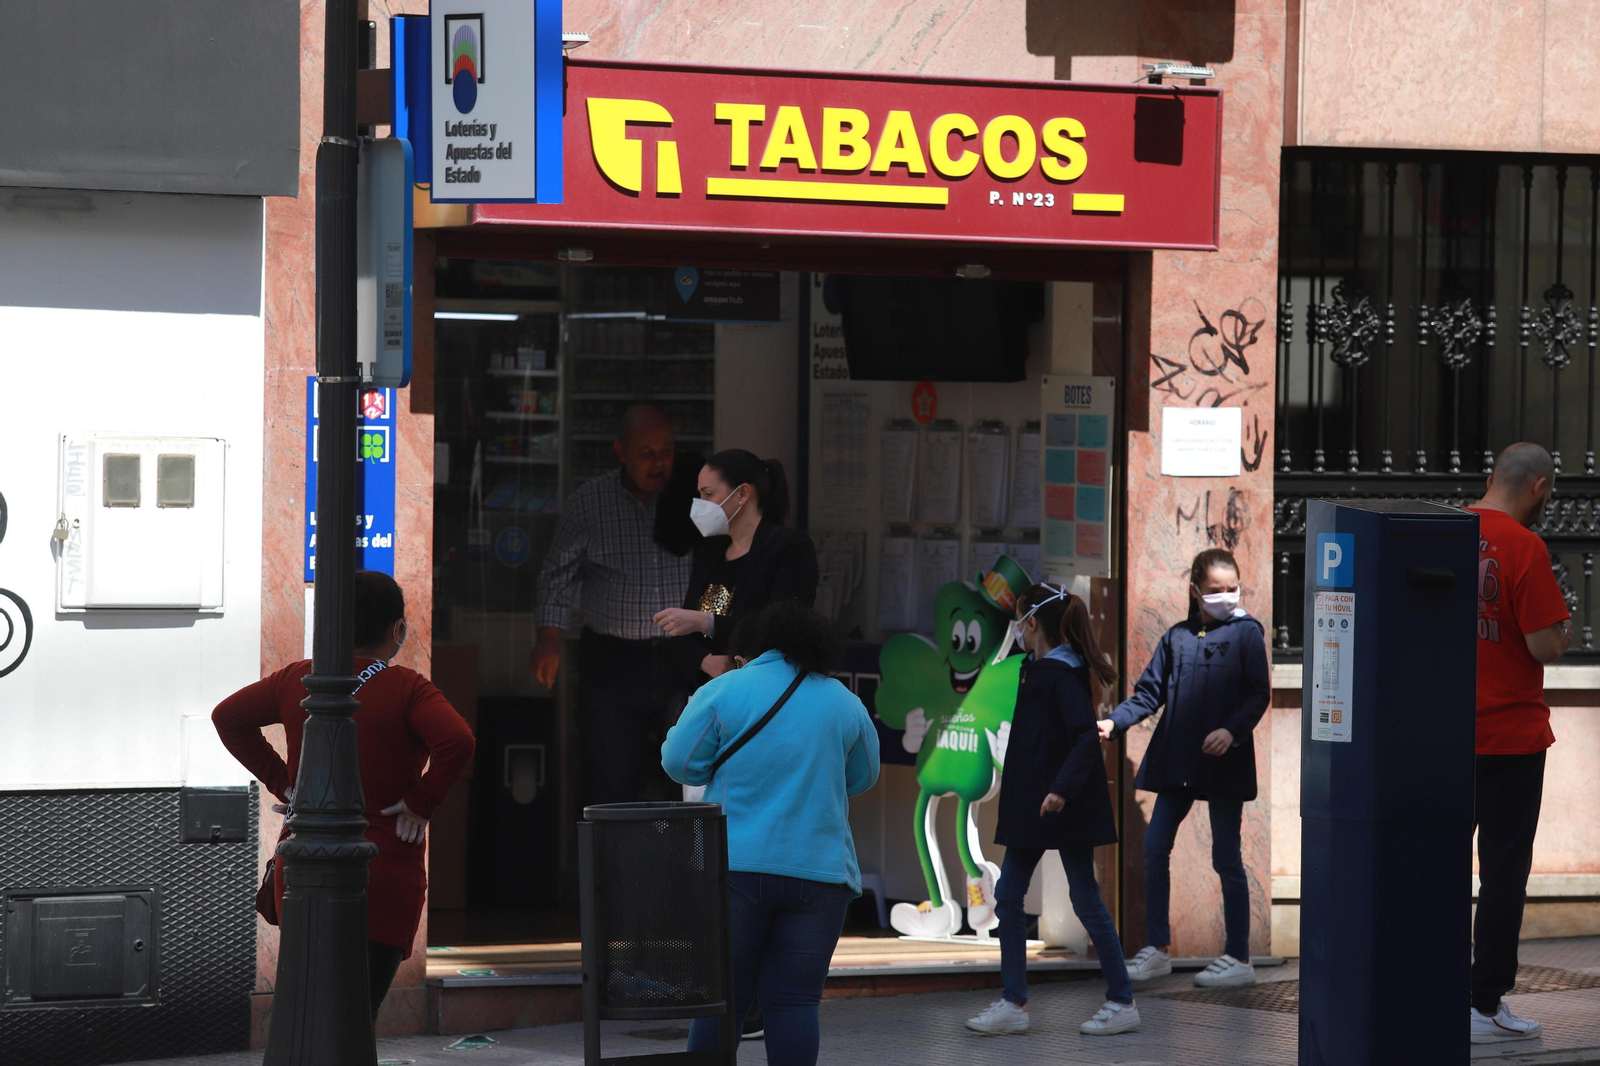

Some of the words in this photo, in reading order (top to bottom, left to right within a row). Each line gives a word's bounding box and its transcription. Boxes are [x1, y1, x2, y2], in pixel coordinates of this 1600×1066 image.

[445, 119, 488, 138] Loterías
[489, 123, 497, 141] y
[714, 102, 1088, 182] TABACOS
[446, 144, 494, 164] Apuestas
[496, 142, 512, 160] del
[445, 165, 481, 184] Estado
[989, 190, 1004, 206] P.
[813, 363, 848, 380] Estado
[1064, 384, 1092, 406] BOTES
[365, 514, 374, 529] y
[371, 533, 392, 548] del
[1323, 542, 1343, 580] P
[1325, 594, 1339, 602] PAGA
[1340, 595, 1353, 603] CON
[1333, 603, 1351, 612] MÓVIL
